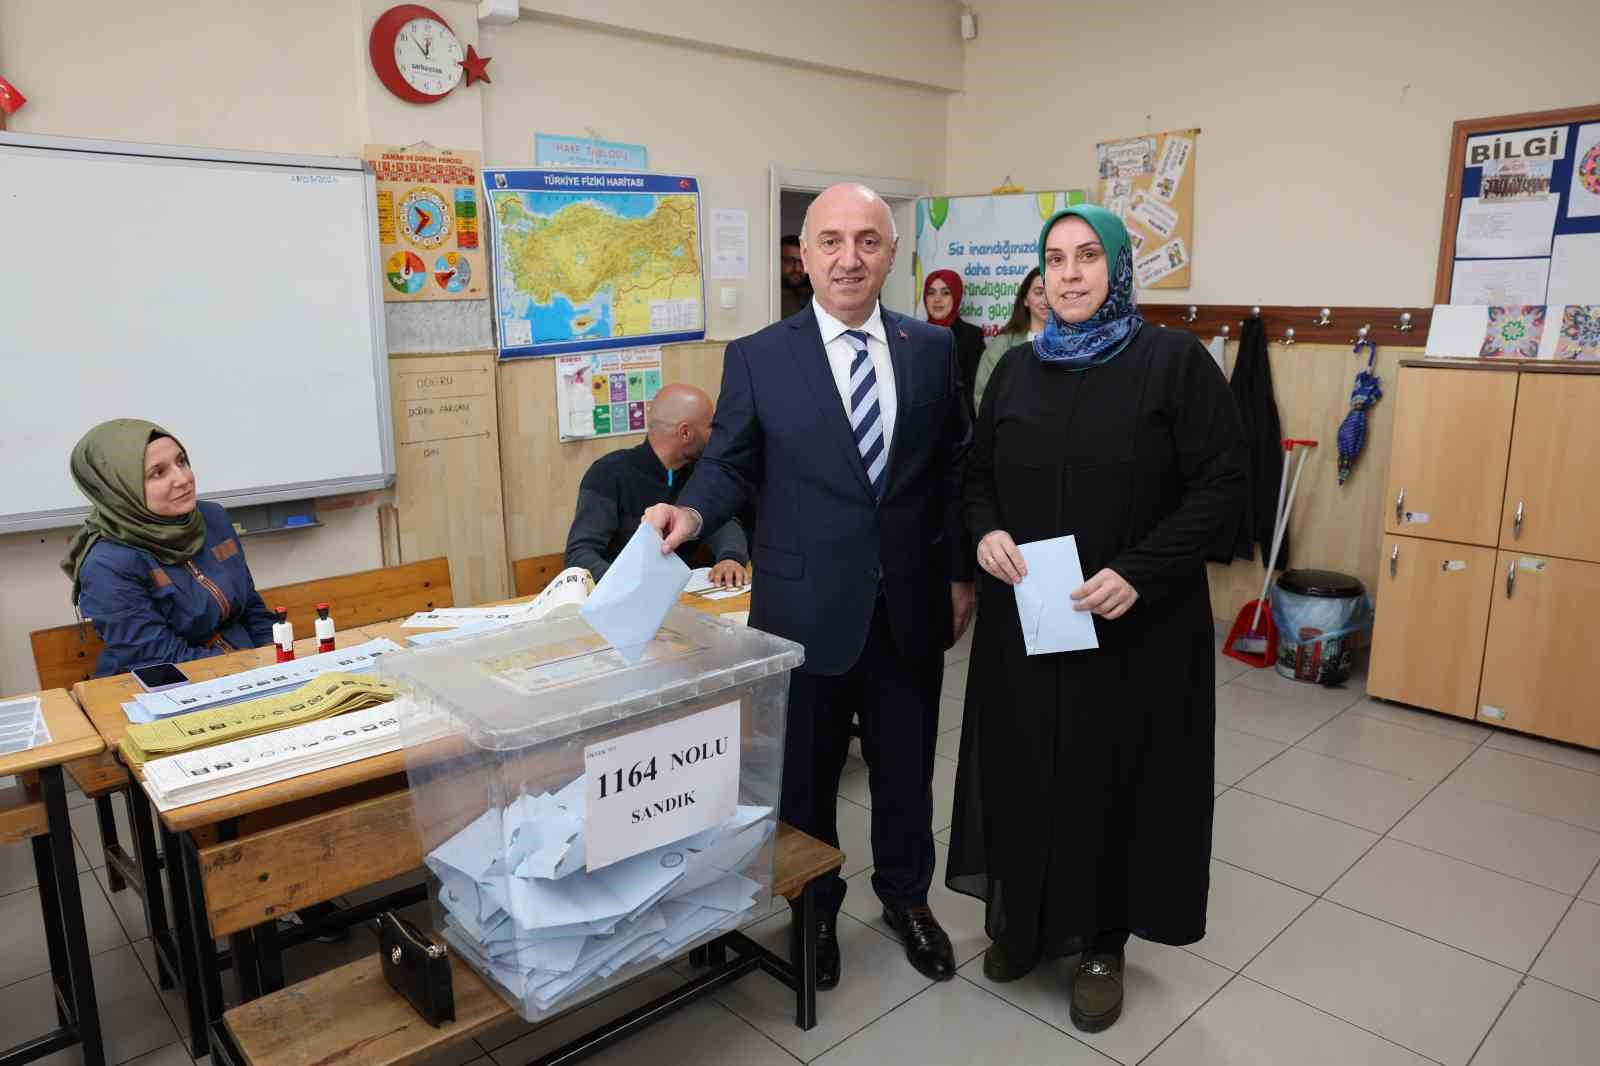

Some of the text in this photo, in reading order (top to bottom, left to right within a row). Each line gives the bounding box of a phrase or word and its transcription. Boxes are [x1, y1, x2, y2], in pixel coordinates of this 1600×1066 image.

[1471, 130, 1559, 165] BİLGİ
[544, 174, 645, 187] TÜRKİYE FİZİKİ HARİTASI
[948, 241, 965, 256] Siz
[964, 262, 1029, 276] daha cesur
[599, 736, 728, 800] 1164 NOLU
[631, 790, 696, 824] SANDIK
